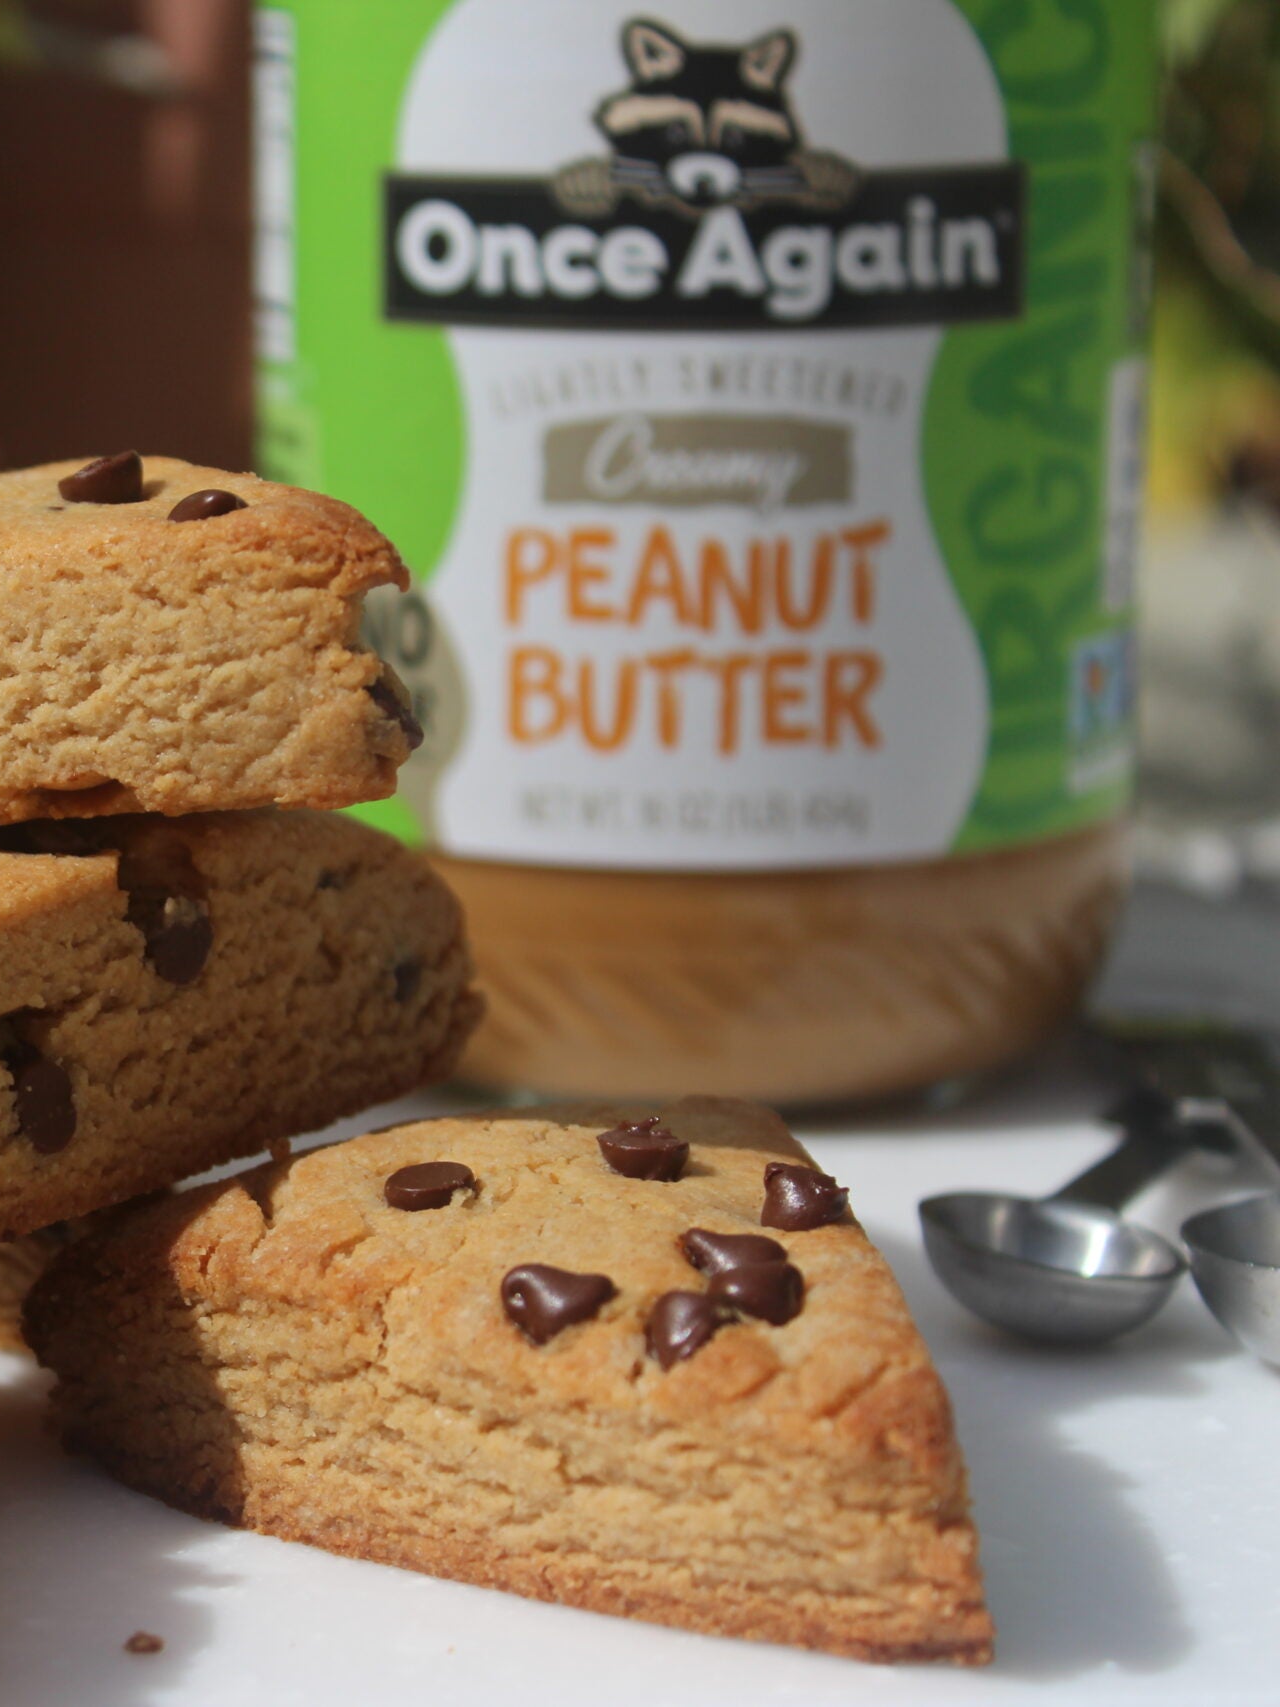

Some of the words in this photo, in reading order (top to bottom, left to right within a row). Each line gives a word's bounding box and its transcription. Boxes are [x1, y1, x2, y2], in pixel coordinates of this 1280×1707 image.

[397, 199, 668, 297] Once
[677, 195, 1000, 318] Again
[584, 413, 810, 517] Creamy
[503, 515, 893, 637] PEANUT
[504, 645, 885, 758] BUTTER
